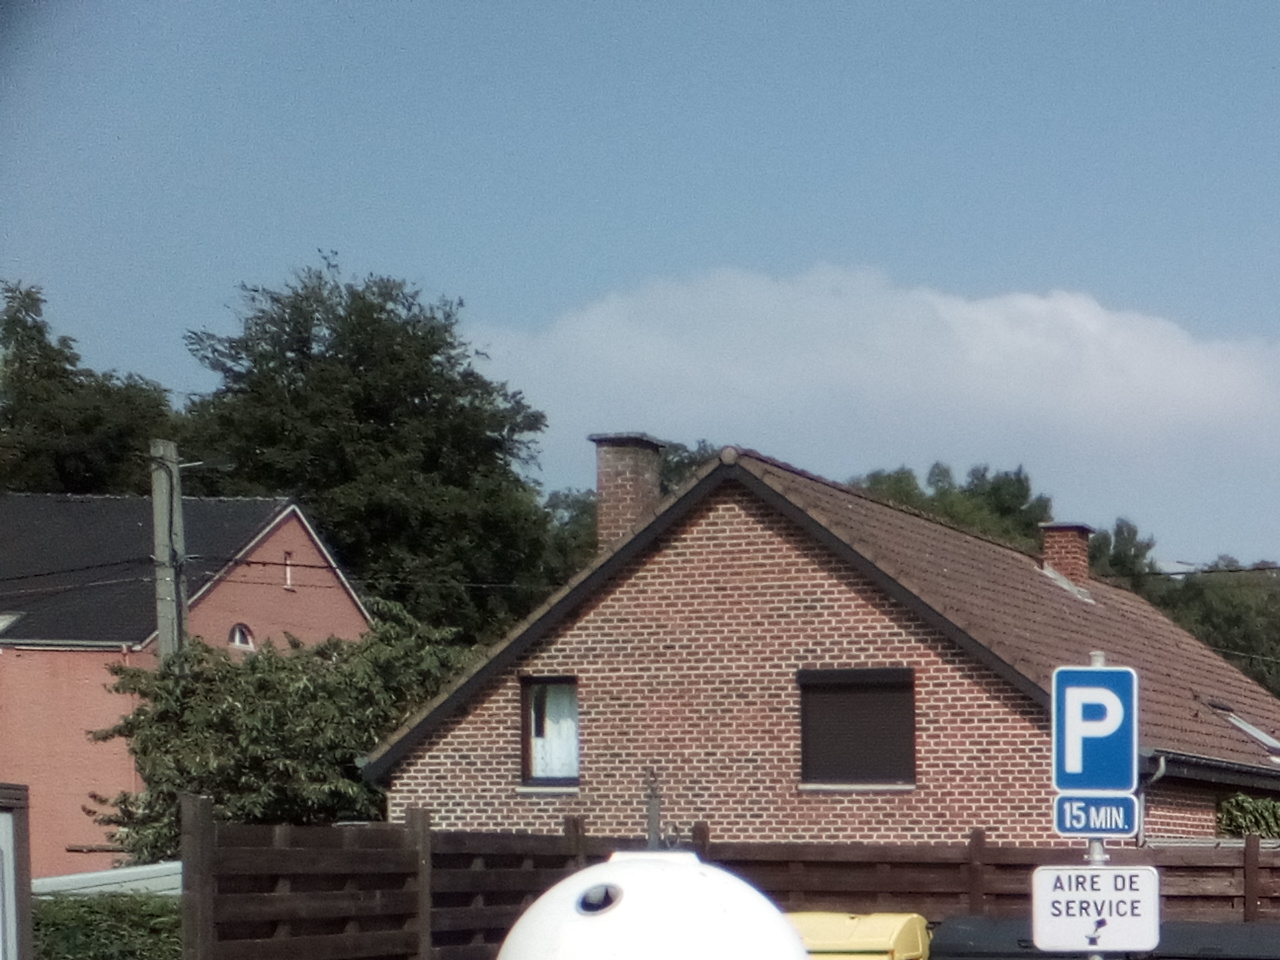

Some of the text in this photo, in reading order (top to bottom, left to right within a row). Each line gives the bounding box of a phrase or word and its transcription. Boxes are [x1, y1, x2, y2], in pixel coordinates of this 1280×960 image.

[1065, 687, 1124, 773] P
[1064, 802, 1129, 829] 15 MIN.
[1053, 875, 1140, 891] AIRE DE
[1051, 900, 1142, 917] SERVICE
